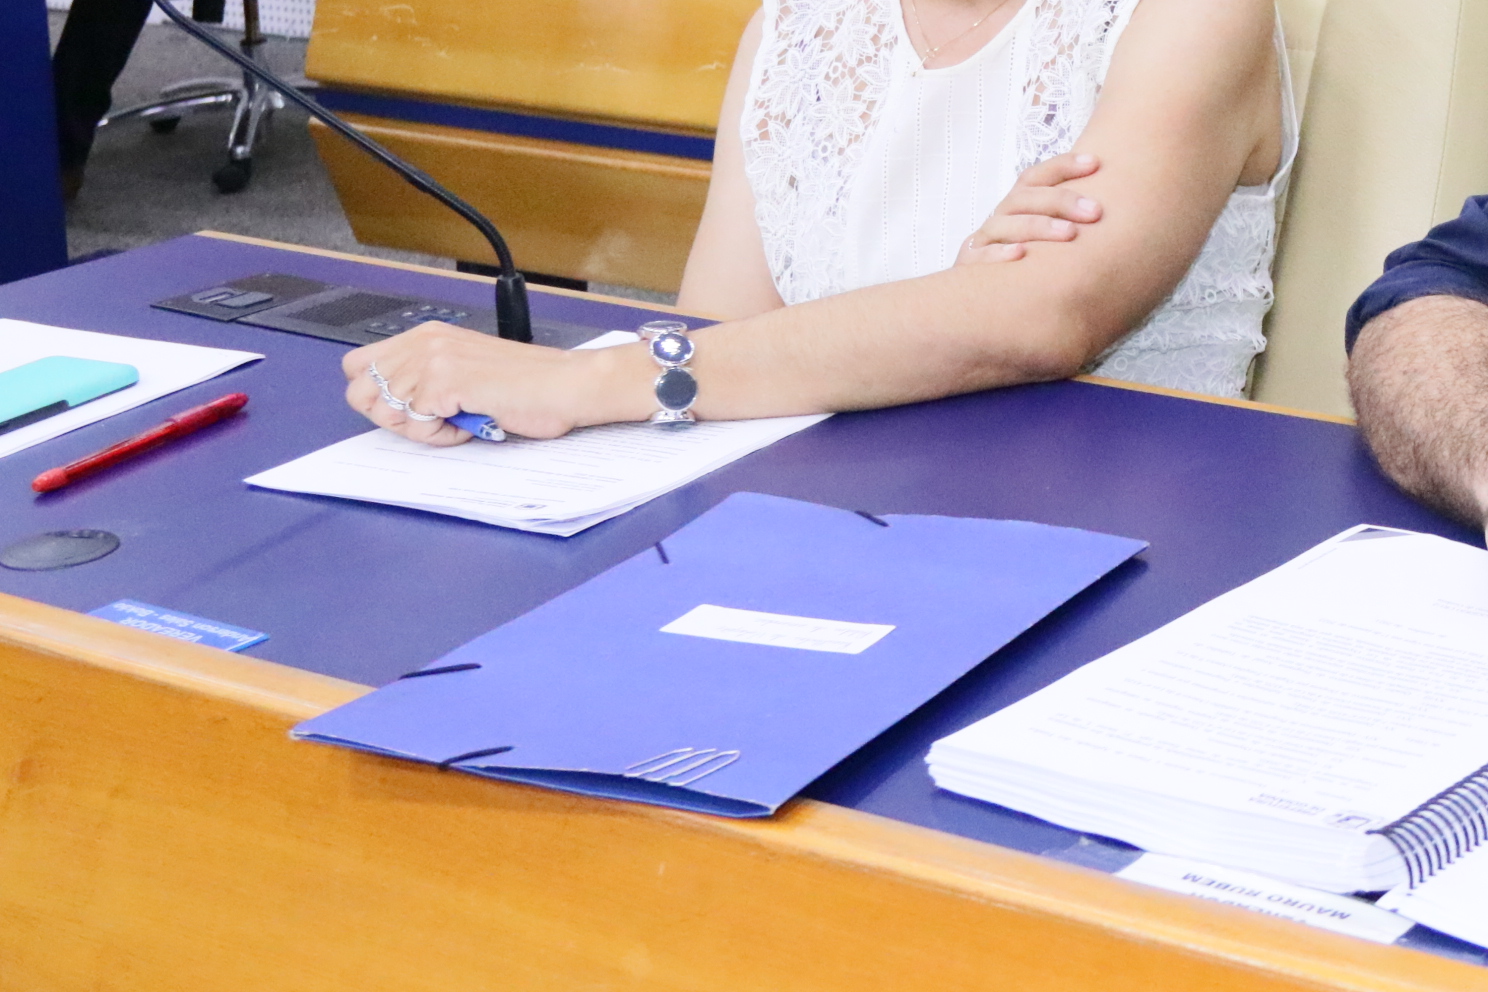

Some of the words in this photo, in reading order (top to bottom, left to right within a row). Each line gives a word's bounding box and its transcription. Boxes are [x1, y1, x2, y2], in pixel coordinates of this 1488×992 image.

[120, 617, 203, 643] VEREADOR
[1182, 872, 1263, 897] RUBEM
[1267, 893, 1351, 920] MAURO
